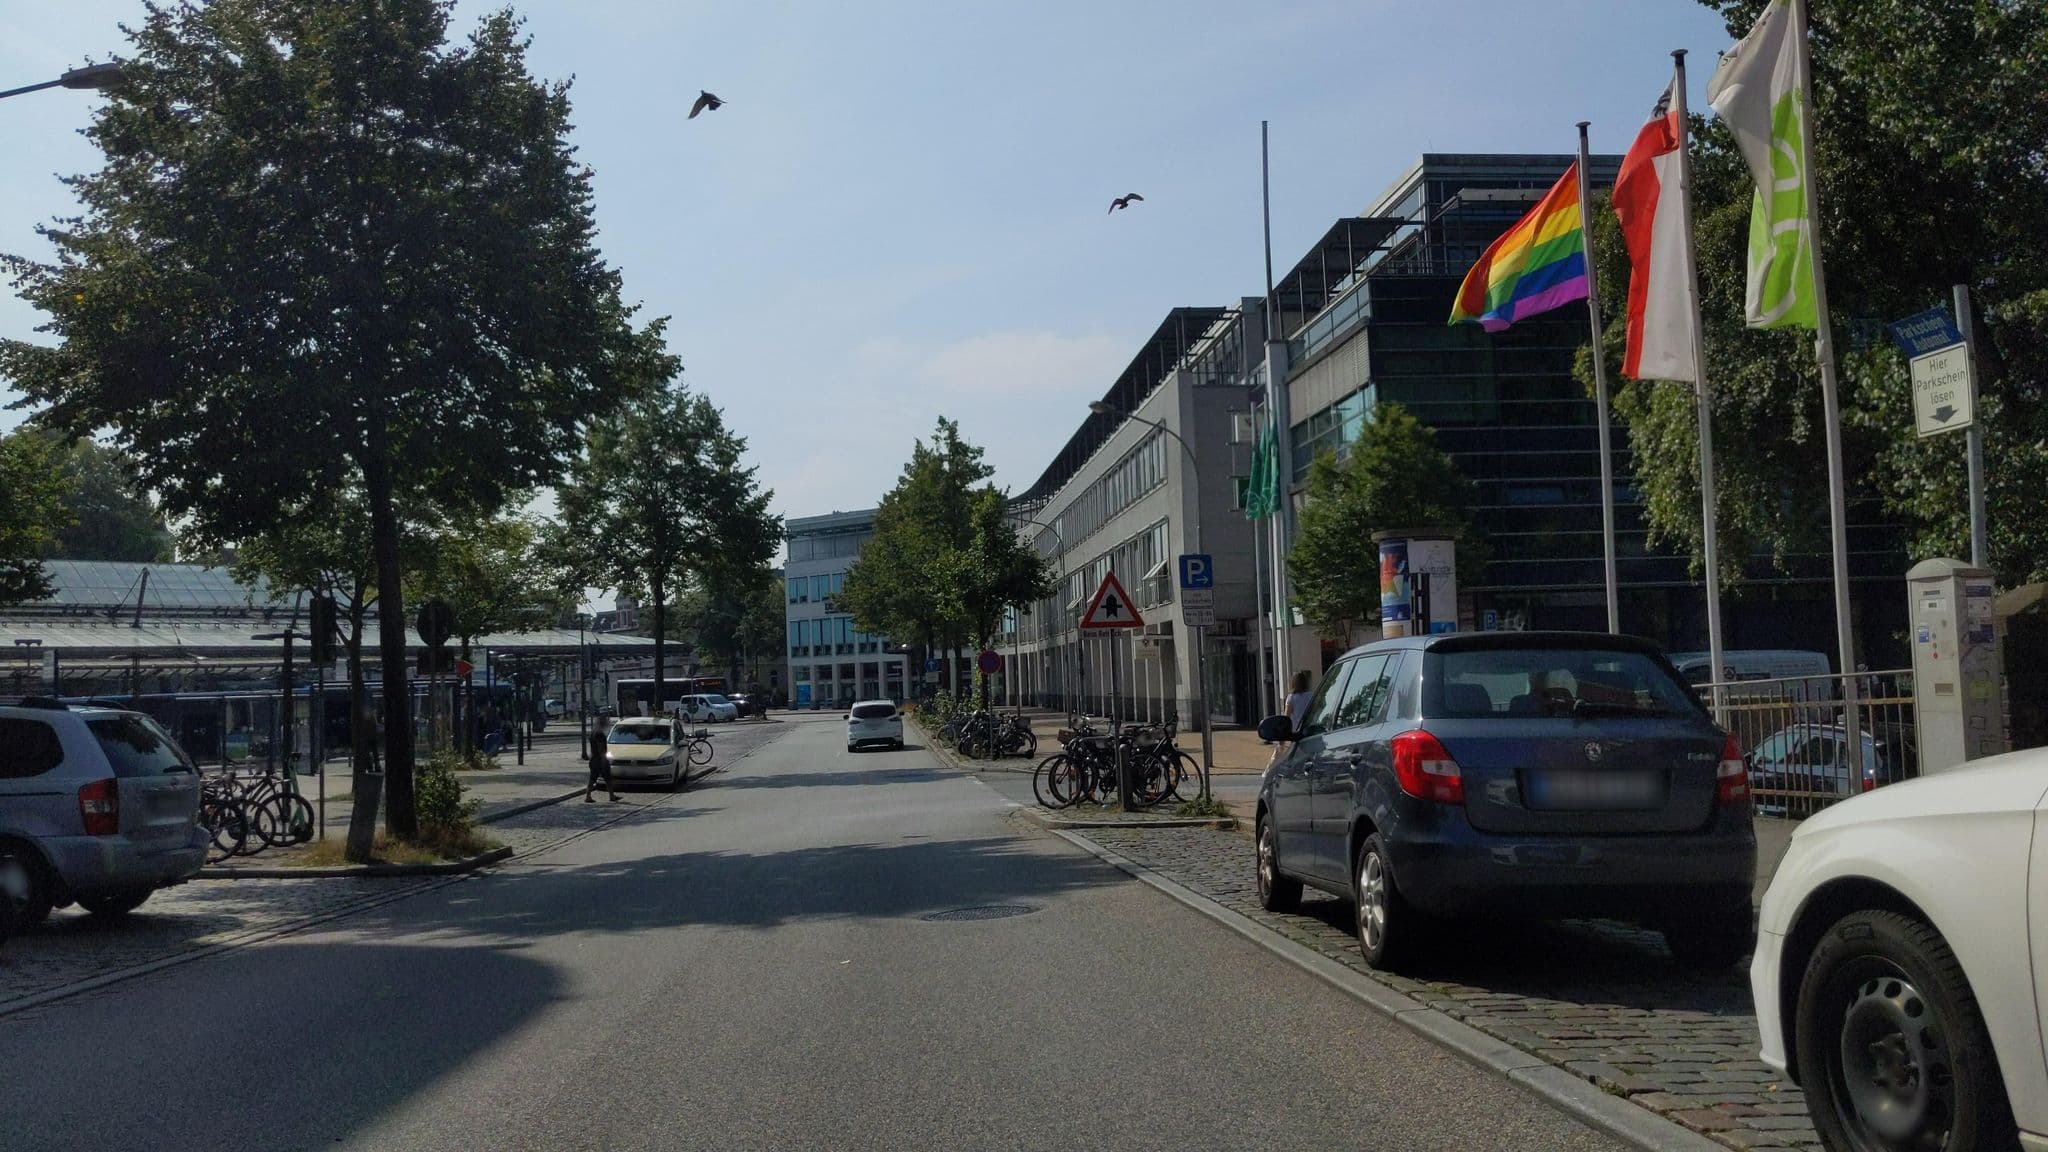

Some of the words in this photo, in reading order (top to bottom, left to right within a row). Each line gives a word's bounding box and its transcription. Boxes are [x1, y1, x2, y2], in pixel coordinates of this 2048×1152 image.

[1929, 357, 1948, 372] Hier
[1916, 370, 1966, 392] Parkschein
[1930, 389, 1955, 406] lösen
[1186, 558, 1205, 585] P
